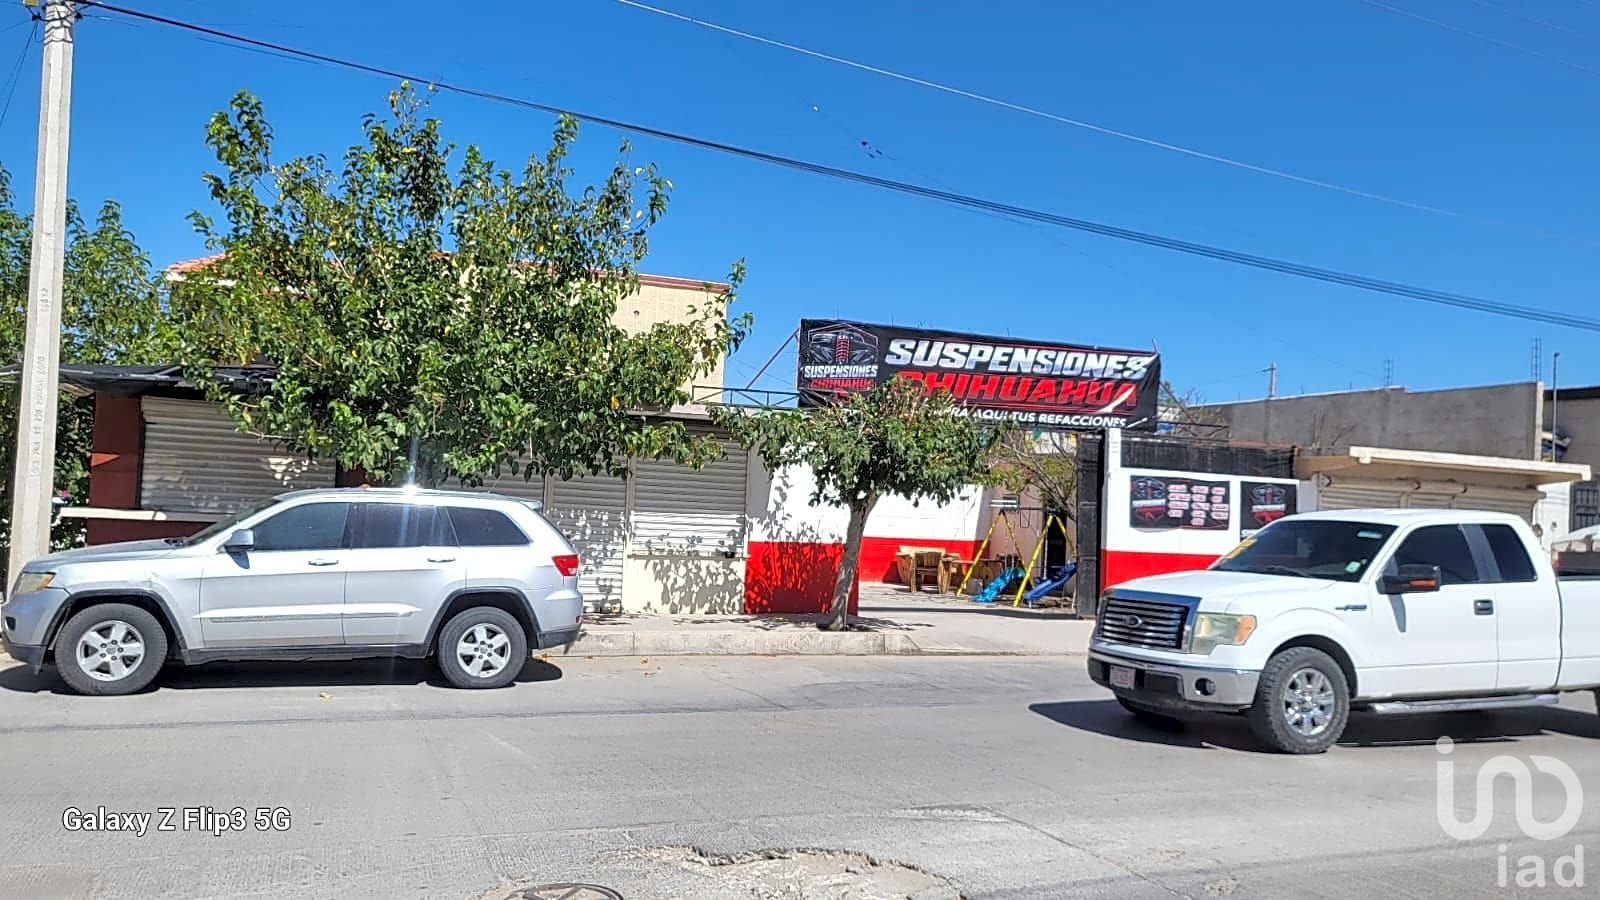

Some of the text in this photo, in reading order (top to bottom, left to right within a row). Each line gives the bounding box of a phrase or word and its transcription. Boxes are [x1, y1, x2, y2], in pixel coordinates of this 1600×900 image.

[885, 339, 1148, 380] SUSPENSIONES
[804, 365, 878, 378] SUSPENSIONES
[1012, 411, 1036, 422] TUS
[1039, 414, 1126, 427] REFACCIONES
